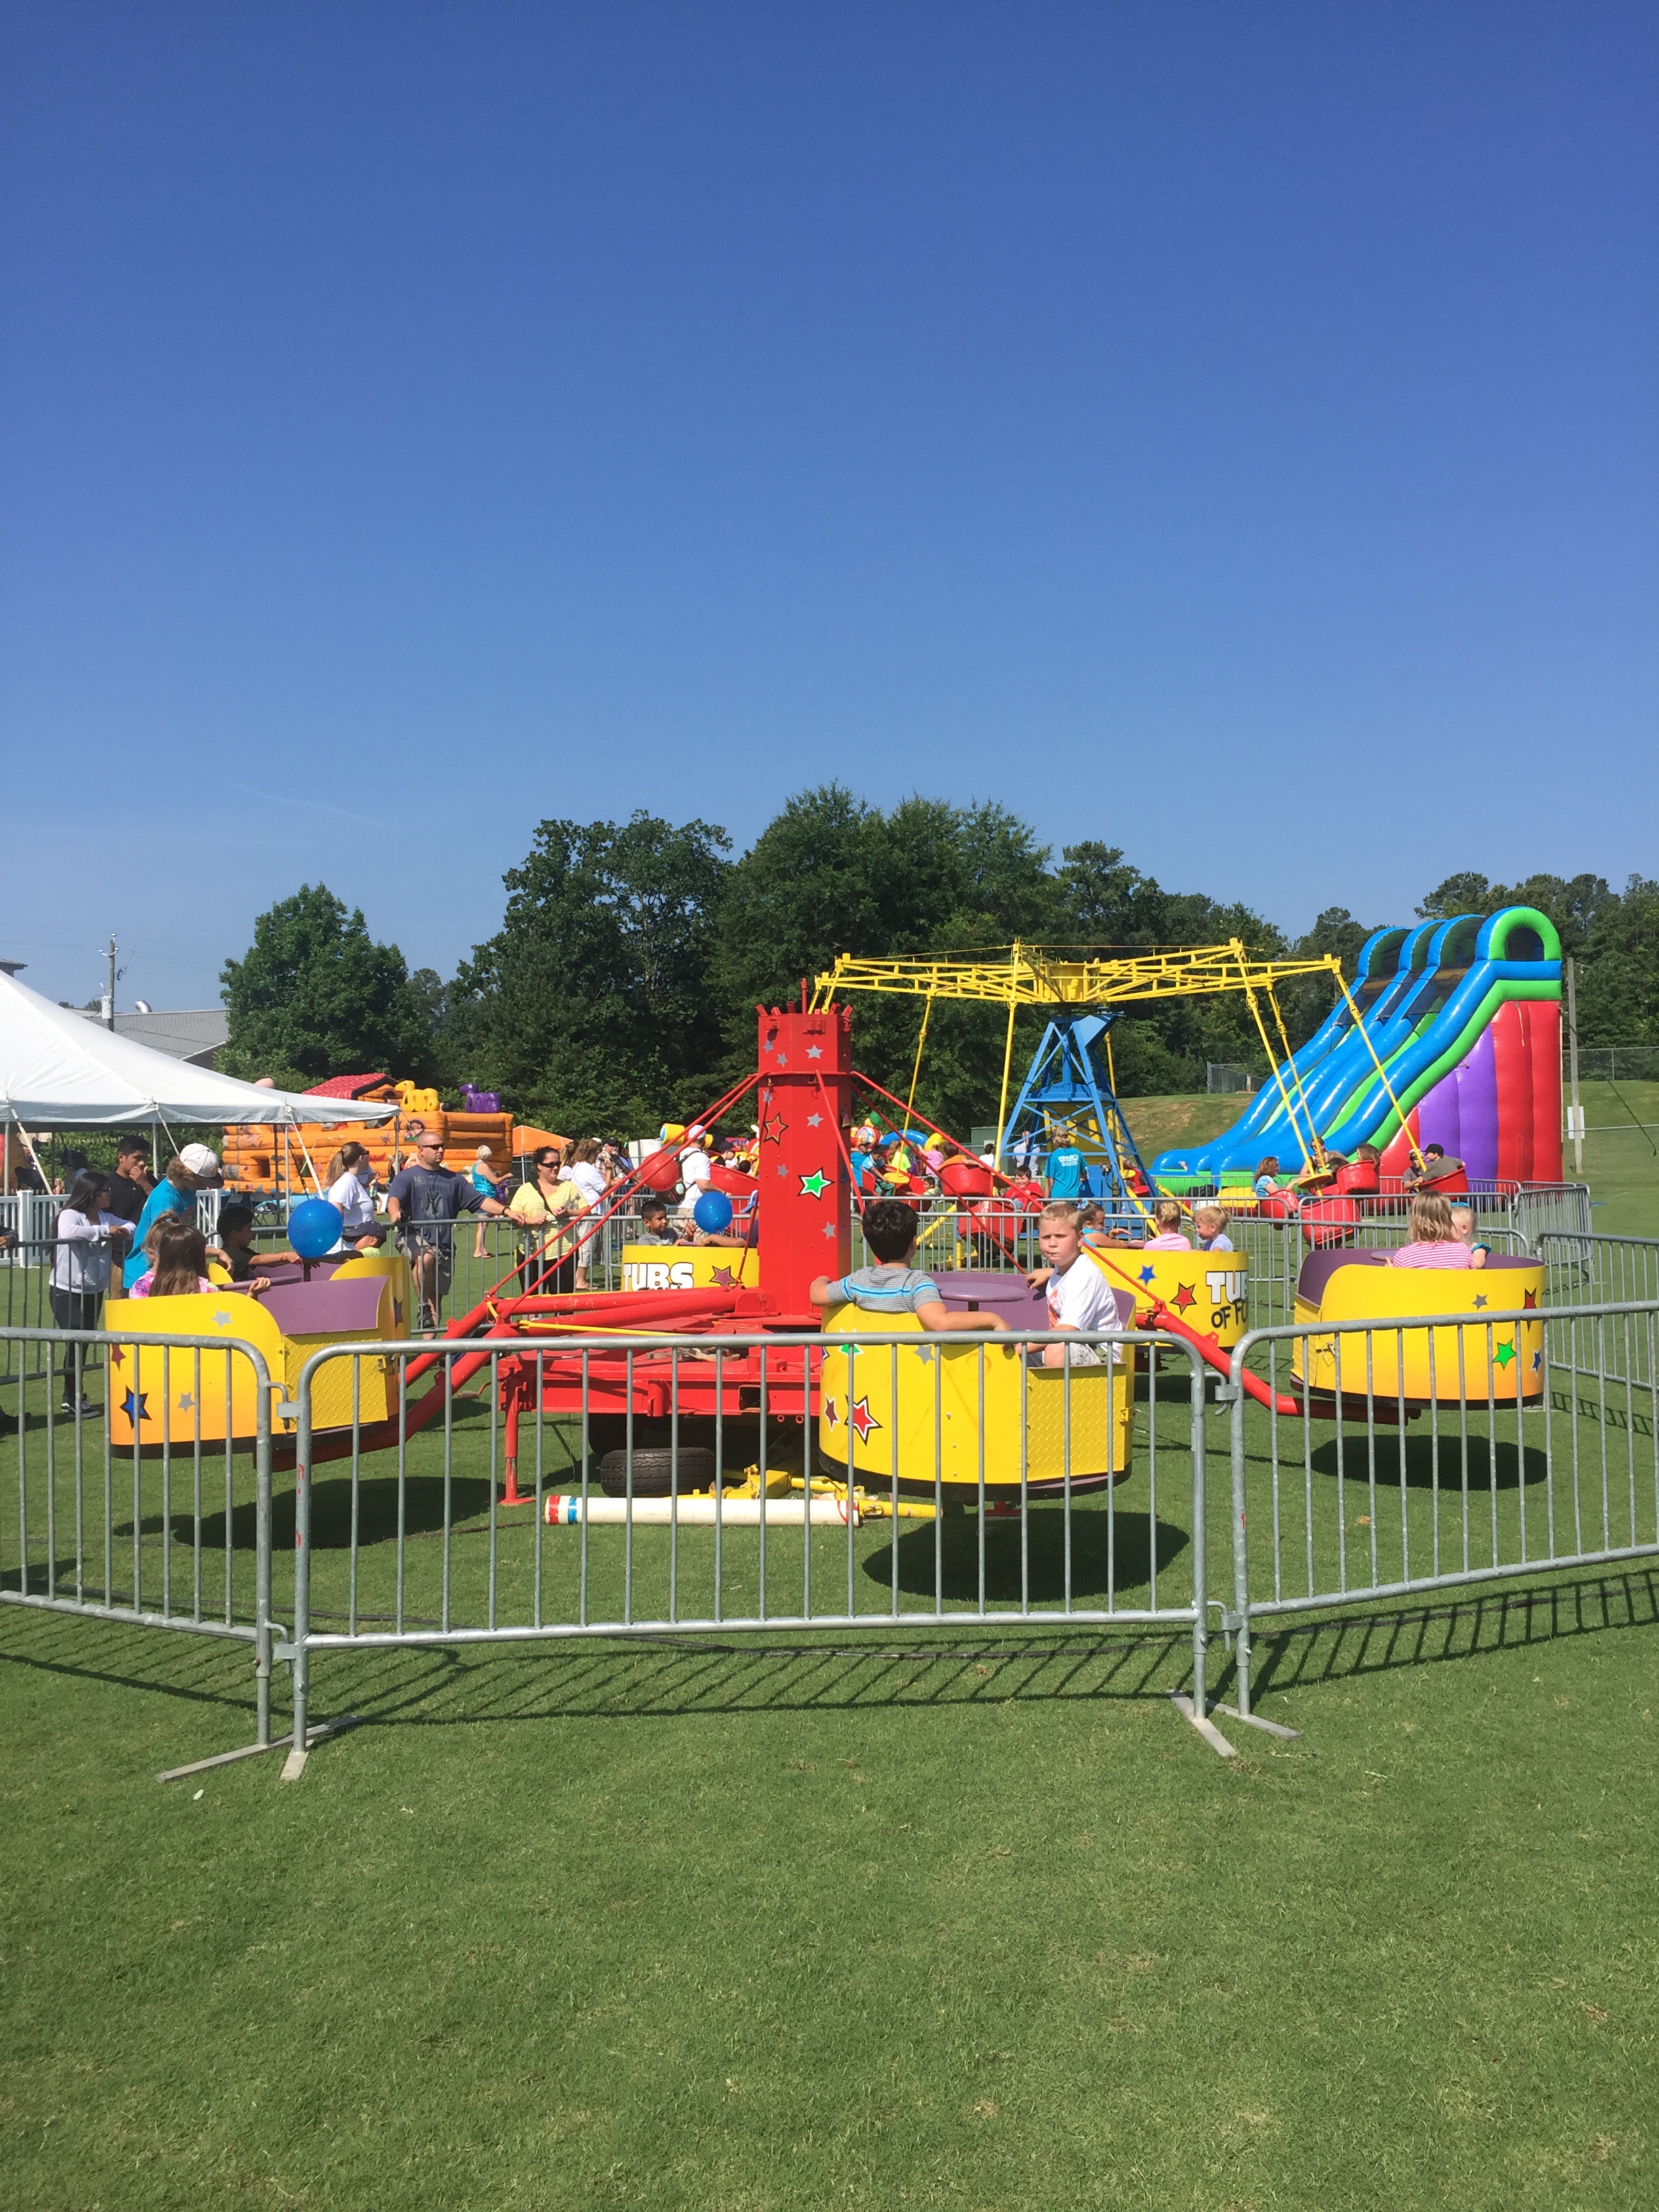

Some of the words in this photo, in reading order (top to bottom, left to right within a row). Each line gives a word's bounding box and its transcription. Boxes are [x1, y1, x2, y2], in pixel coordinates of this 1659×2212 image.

[623, 1261, 695, 1292] TUBS
[1210, 1305, 1231, 1330] OF
[1231, 1296, 1248, 1326] FU
